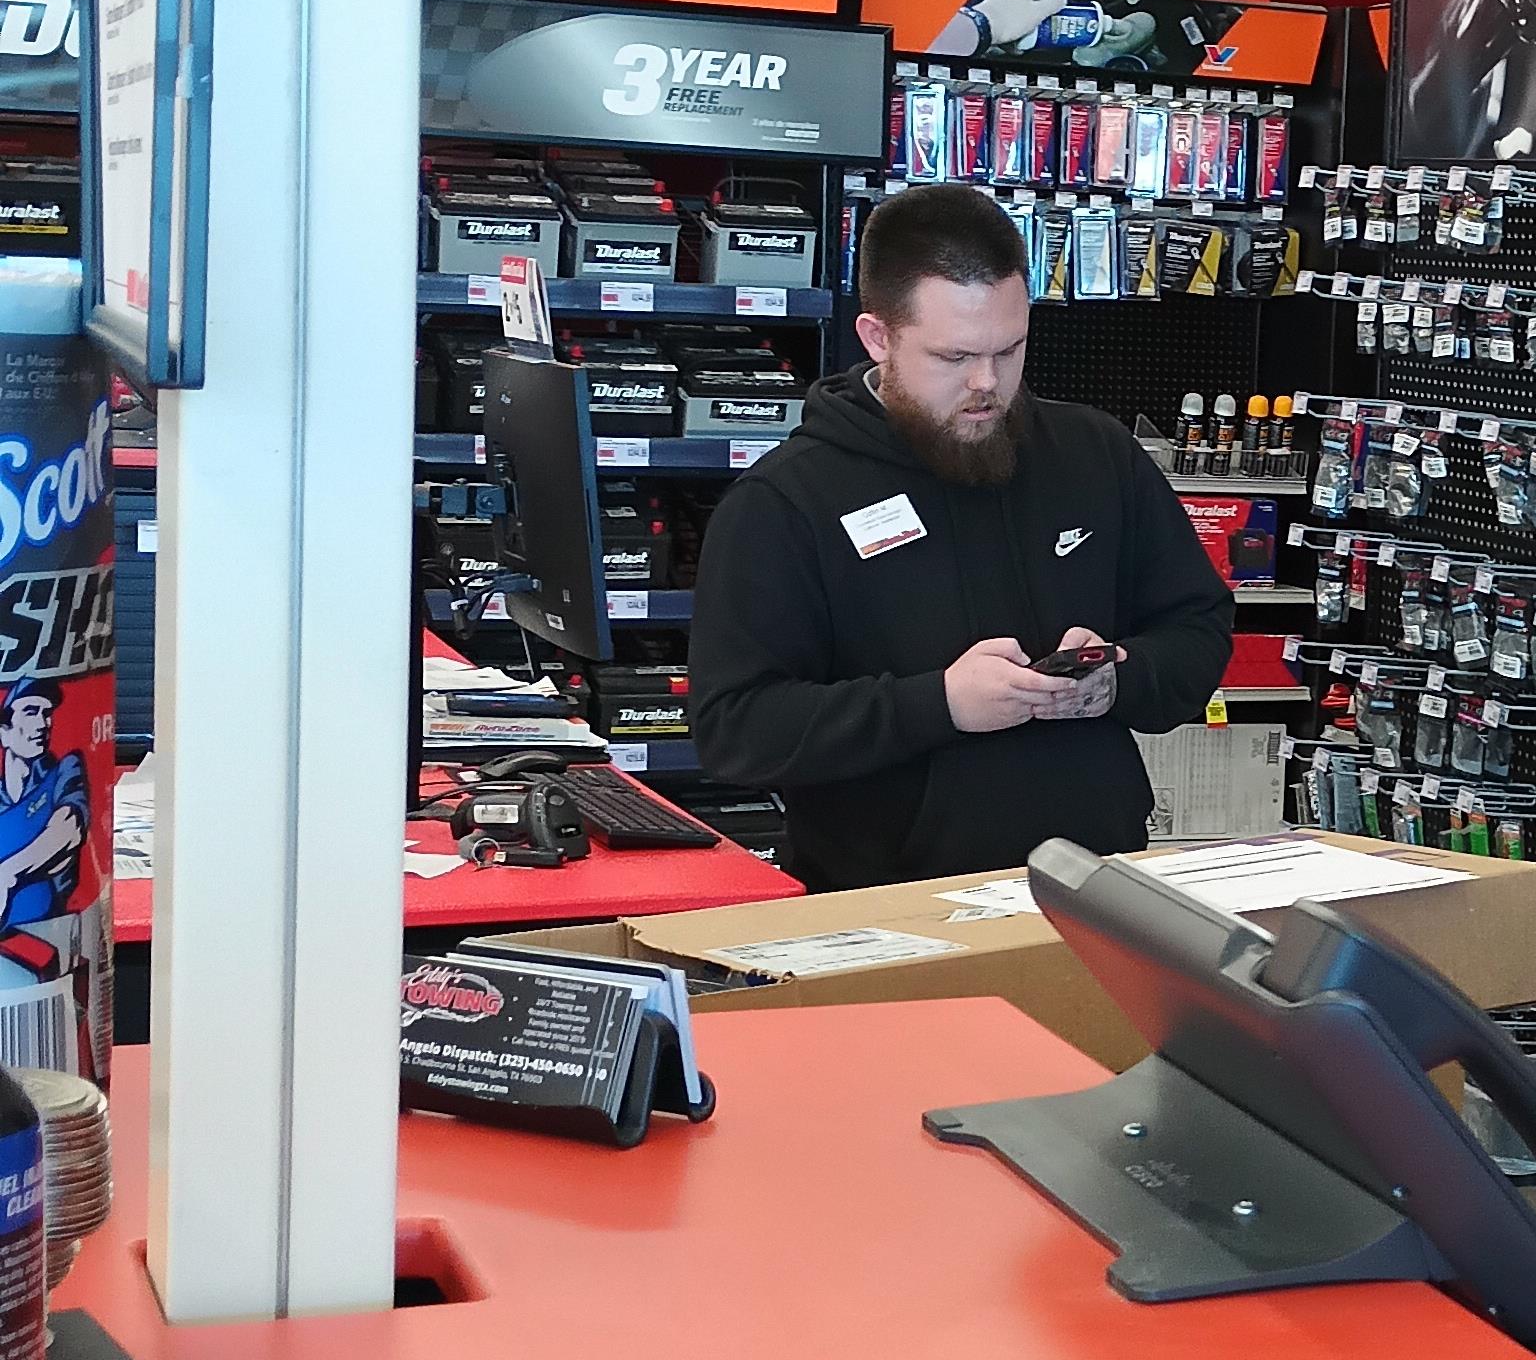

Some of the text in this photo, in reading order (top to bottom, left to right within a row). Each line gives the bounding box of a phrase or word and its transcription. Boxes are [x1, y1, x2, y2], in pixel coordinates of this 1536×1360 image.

[602, 42, 788, 117] 3 YEAR
[665, 87, 723, 105] FREE
[662, 101, 745, 117] REPLACEMENT
[0, 200, 62, 222] uralast
[466, 220, 533, 238] Duralast
[736, 232, 799, 248] Duralast
[595, 242, 662, 261] Duralast
[590, 383, 666, 400] Duralast
[718, 401, 780, 417] Duralast
[618, 707, 685, 722] Duralast
[401, 1037, 499, 1065] Angelo Dispatch:
